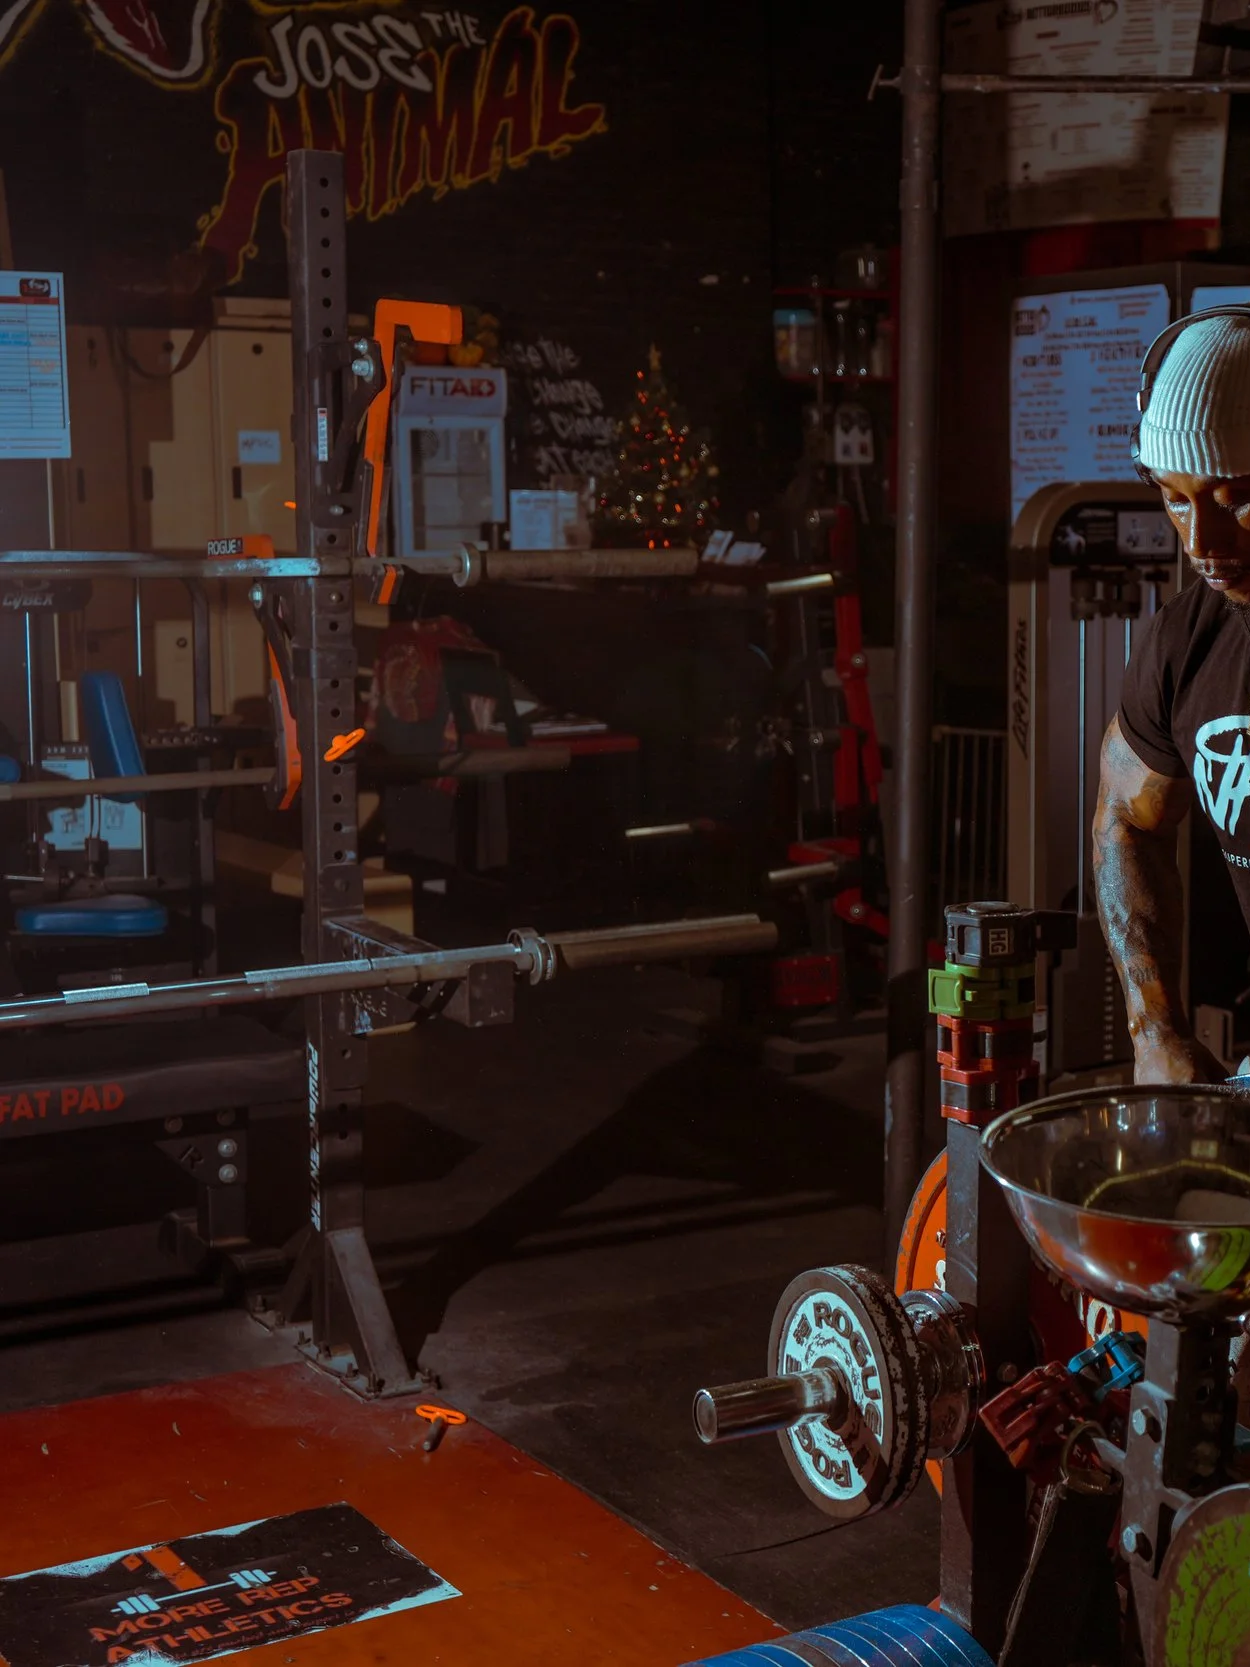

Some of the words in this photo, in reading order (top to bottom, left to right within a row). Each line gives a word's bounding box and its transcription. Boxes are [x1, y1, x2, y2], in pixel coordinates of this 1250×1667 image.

[253, 14, 433, 99] JOSE
[421, 10, 488, 48] THE
[194, 5, 609, 284] ANIMAL
[410, 376, 496, 397] FITAID
[207, 539, 237, 556] ROGUE
[0, 1090, 53, 1126] FAT
[61, 1082, 126, 1117] PAD
[812, 1302, 882, 1437] ROGUE
[88, 1597, 231, 1643] MORE
[235, 1575, 321, 1607] REP
[106, 1592, 354, 1664] ATHLETICS
